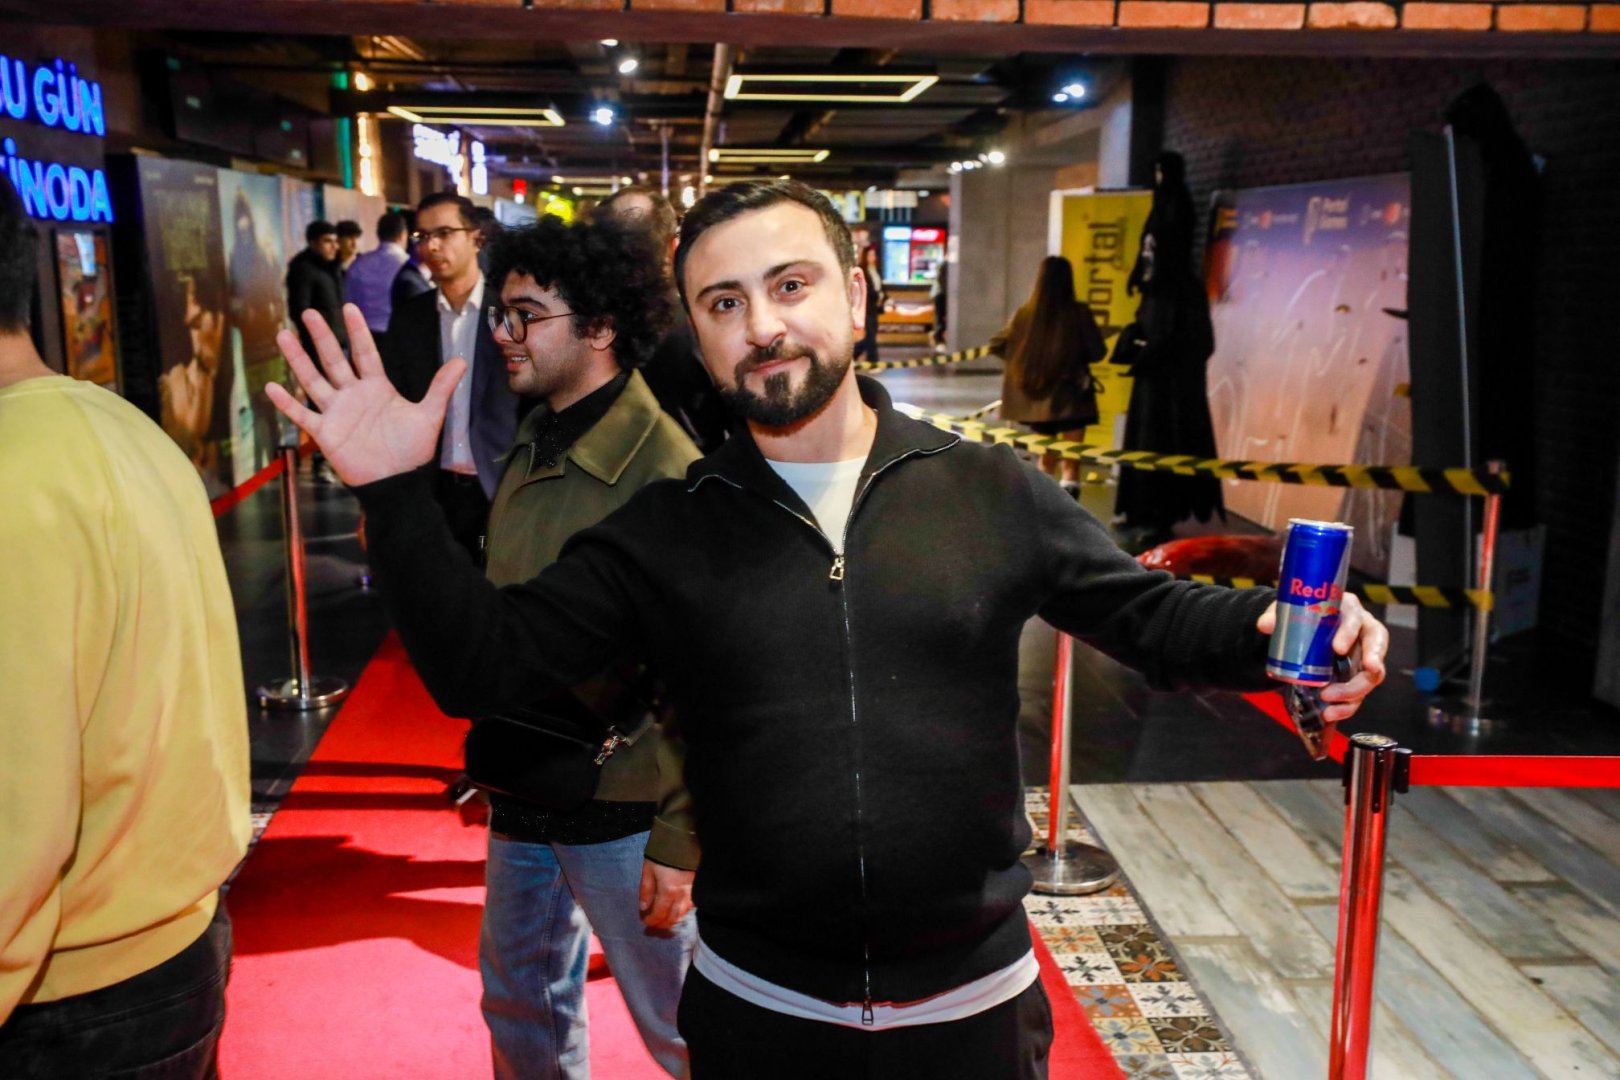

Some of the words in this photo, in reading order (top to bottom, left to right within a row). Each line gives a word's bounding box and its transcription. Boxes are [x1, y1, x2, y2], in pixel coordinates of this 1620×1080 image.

[0, 55, 27, 119] U
[33, 58, 106, 136] GÜN
[0, 137, 114, 223] İNODA
[1290, 577, 1328, 600] Red
